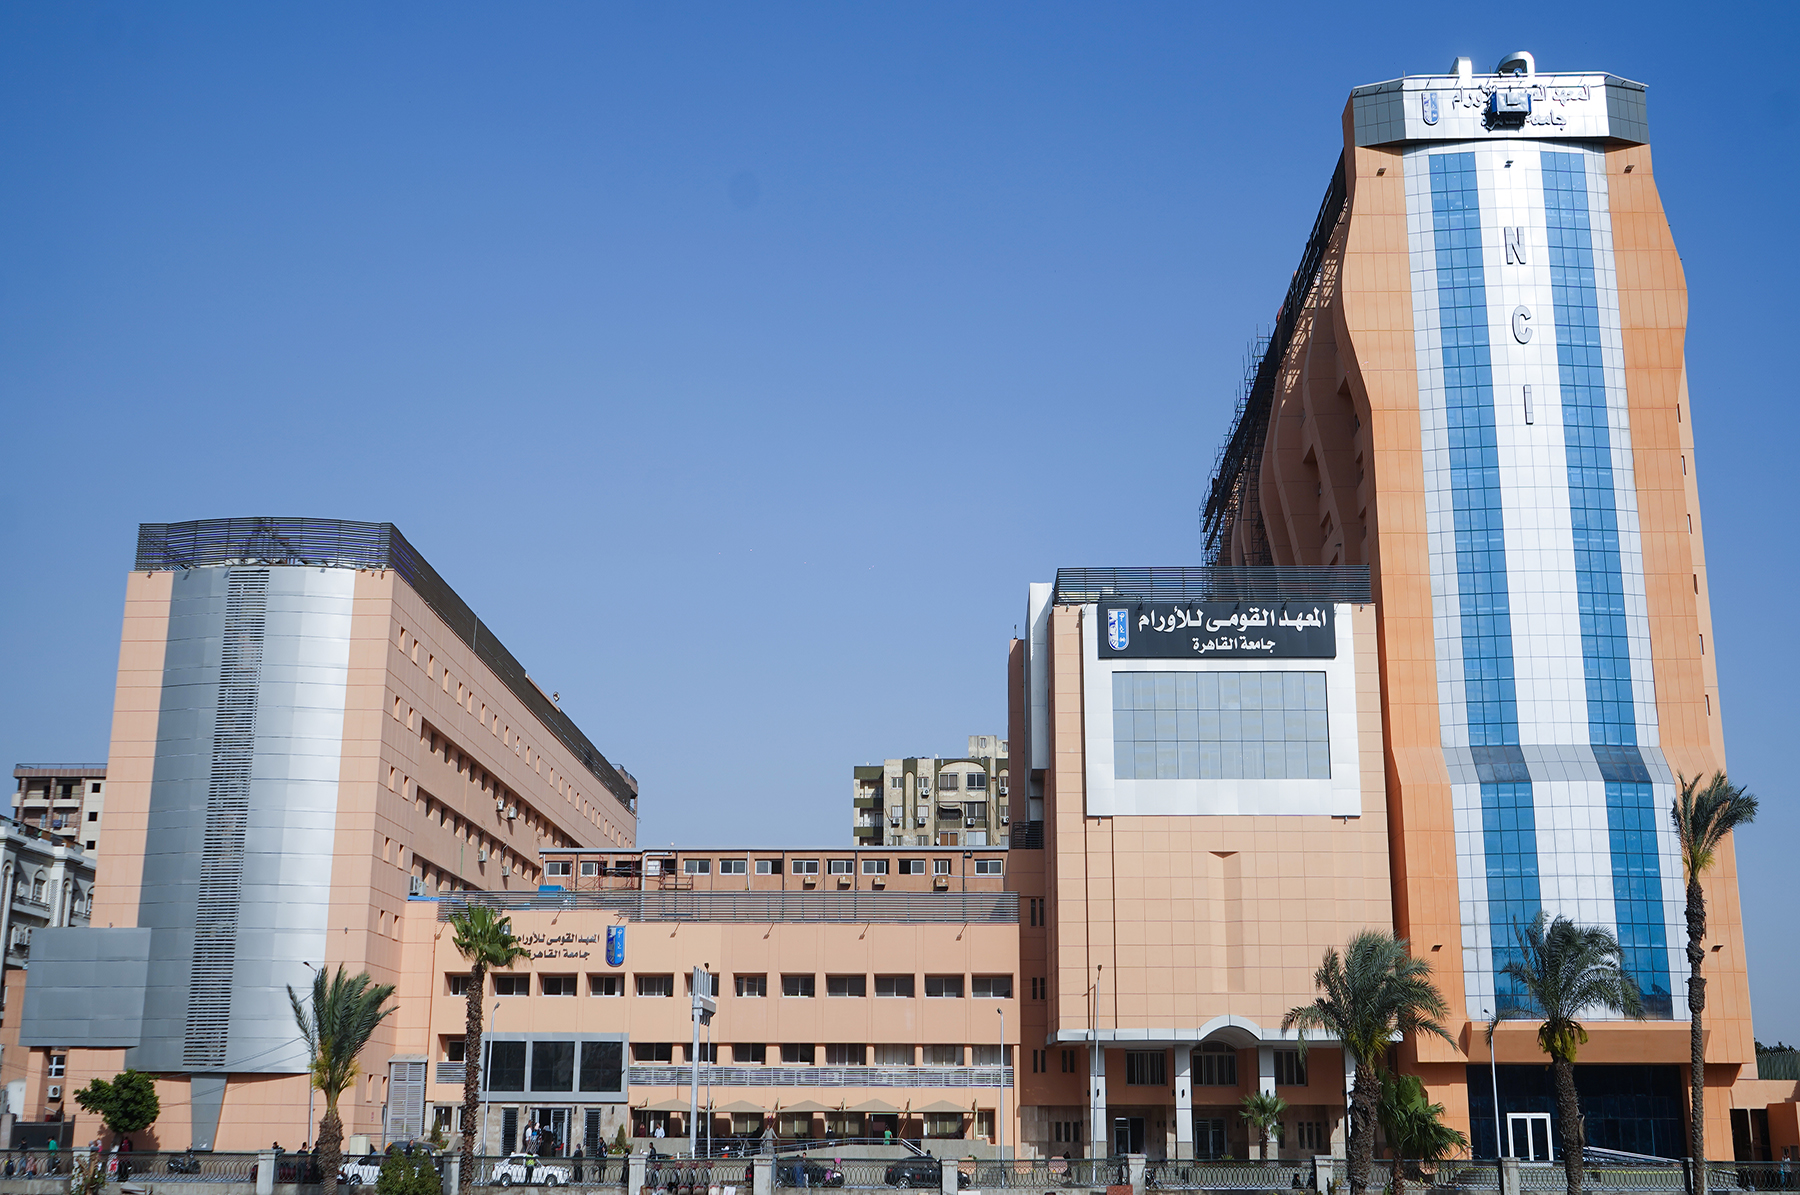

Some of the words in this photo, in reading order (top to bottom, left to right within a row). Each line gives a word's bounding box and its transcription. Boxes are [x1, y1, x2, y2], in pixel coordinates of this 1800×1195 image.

[1138, 605, 1203, 633] للأورام
[1278, 606, 1327, 632] المعهد
[1192, 637, 1238, 654] القاهرة
[1239, 636, 1276, 654] جامعة
[578, 933, 600, 945] المعهد
[563, 948, 590, 960] جامعة
